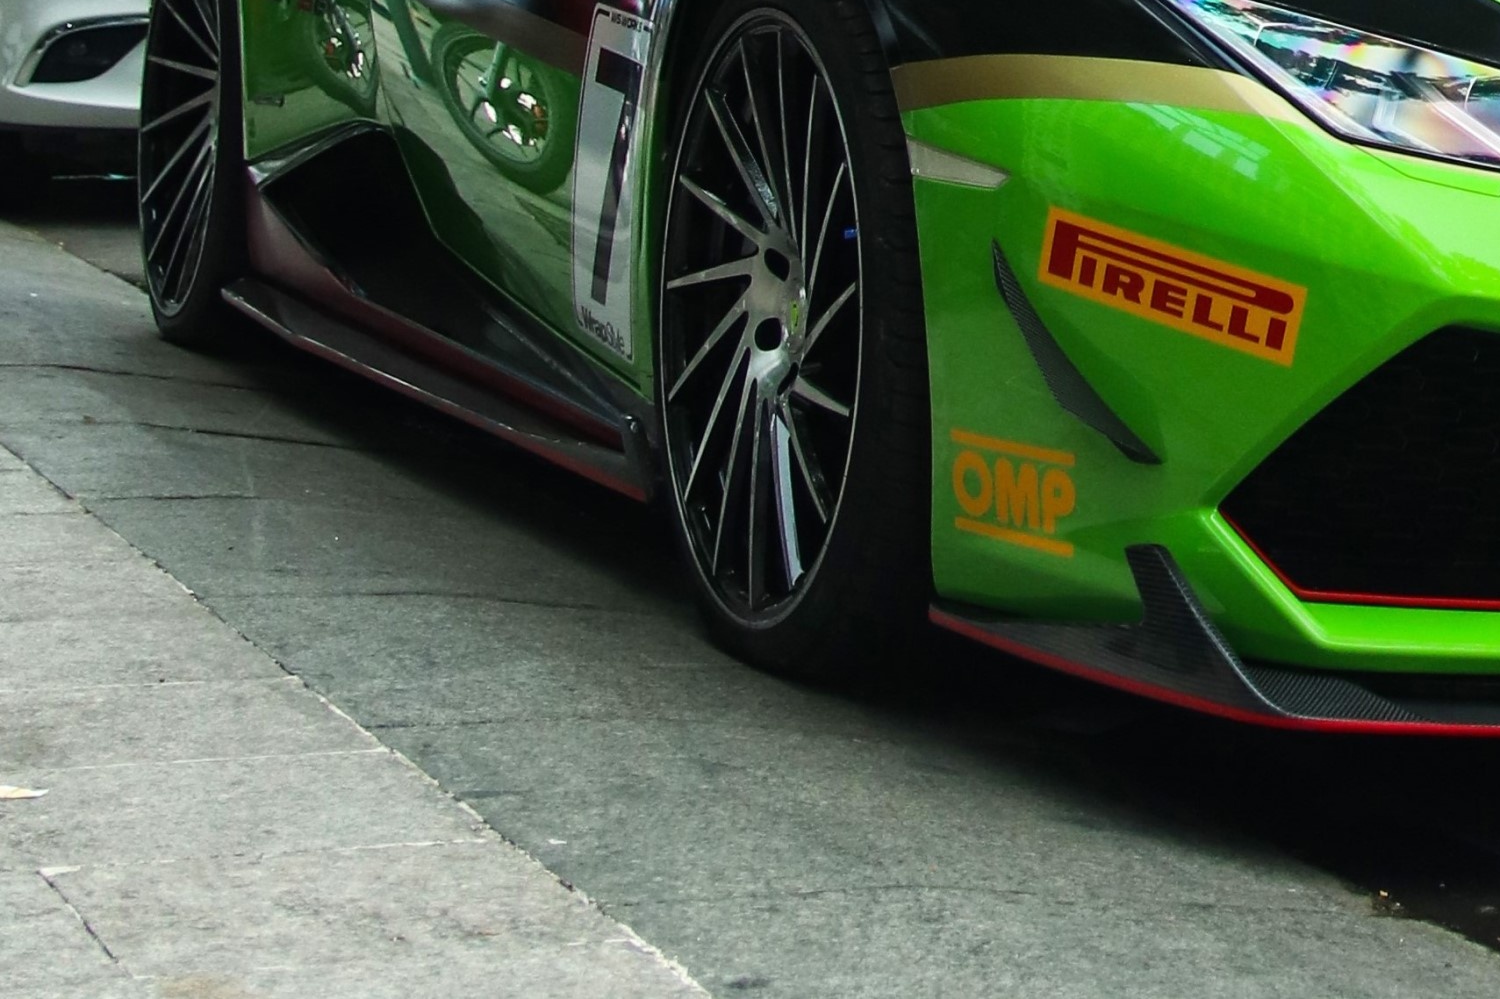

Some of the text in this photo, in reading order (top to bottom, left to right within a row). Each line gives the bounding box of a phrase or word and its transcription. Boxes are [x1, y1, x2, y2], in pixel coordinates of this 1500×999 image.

[590, 47, 644, 306] 7
[1047, 219, 1295, 352] PIRELLI
[952, 450, 1076, 534] OMP
